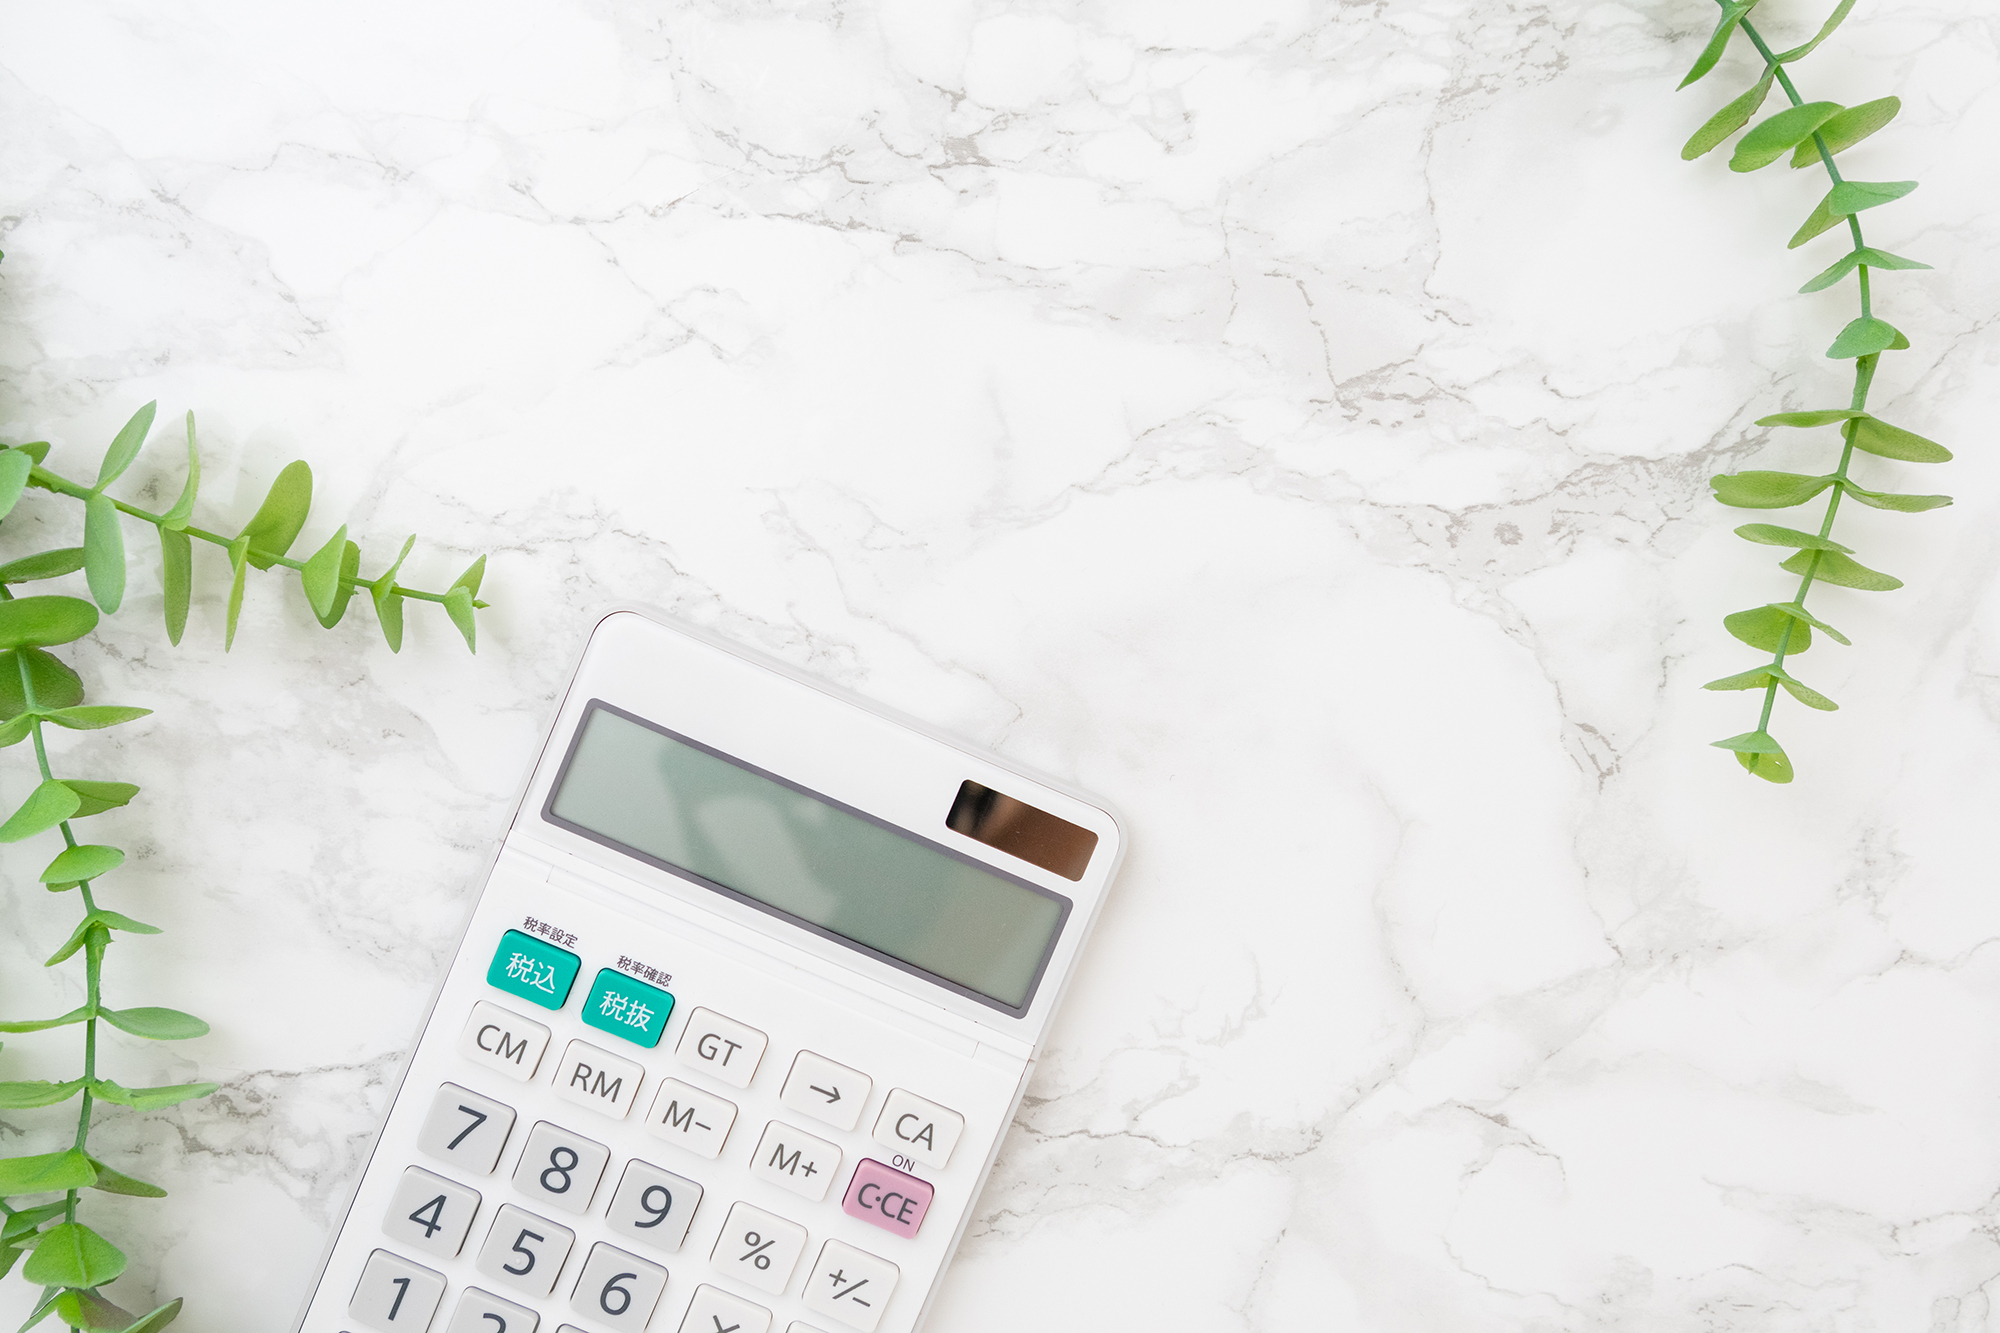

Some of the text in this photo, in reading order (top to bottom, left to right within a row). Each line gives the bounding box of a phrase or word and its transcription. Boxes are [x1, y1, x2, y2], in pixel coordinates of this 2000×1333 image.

[523, 916, 579, 949] 税率設定
[505, 952, 556, 995] 税込
[616, 955, 673, 988] 税率確認
[599, 991, 655, 1033] 税抜
[476, 1024, 529, 1065] CM
[697, 1033, 743, 1067] GT
[569, 1062, 623, 1103] RM
[446, 1104, 488, 1151] 7
[895, 1113, 934, 1151] CA
[540, 1146, 579, 1195] 8
[768, 1143, 818, 1178] M+
[892, 1154, 916, 1173] ON
[408, 1194, 448, 1239] 4
[634, 1184, 673, 1229] 9
[502, 1228, 546, 1276] 5
[387, 1277, 411, 1322] 1
[599, 1272, 638, 1316] 6
